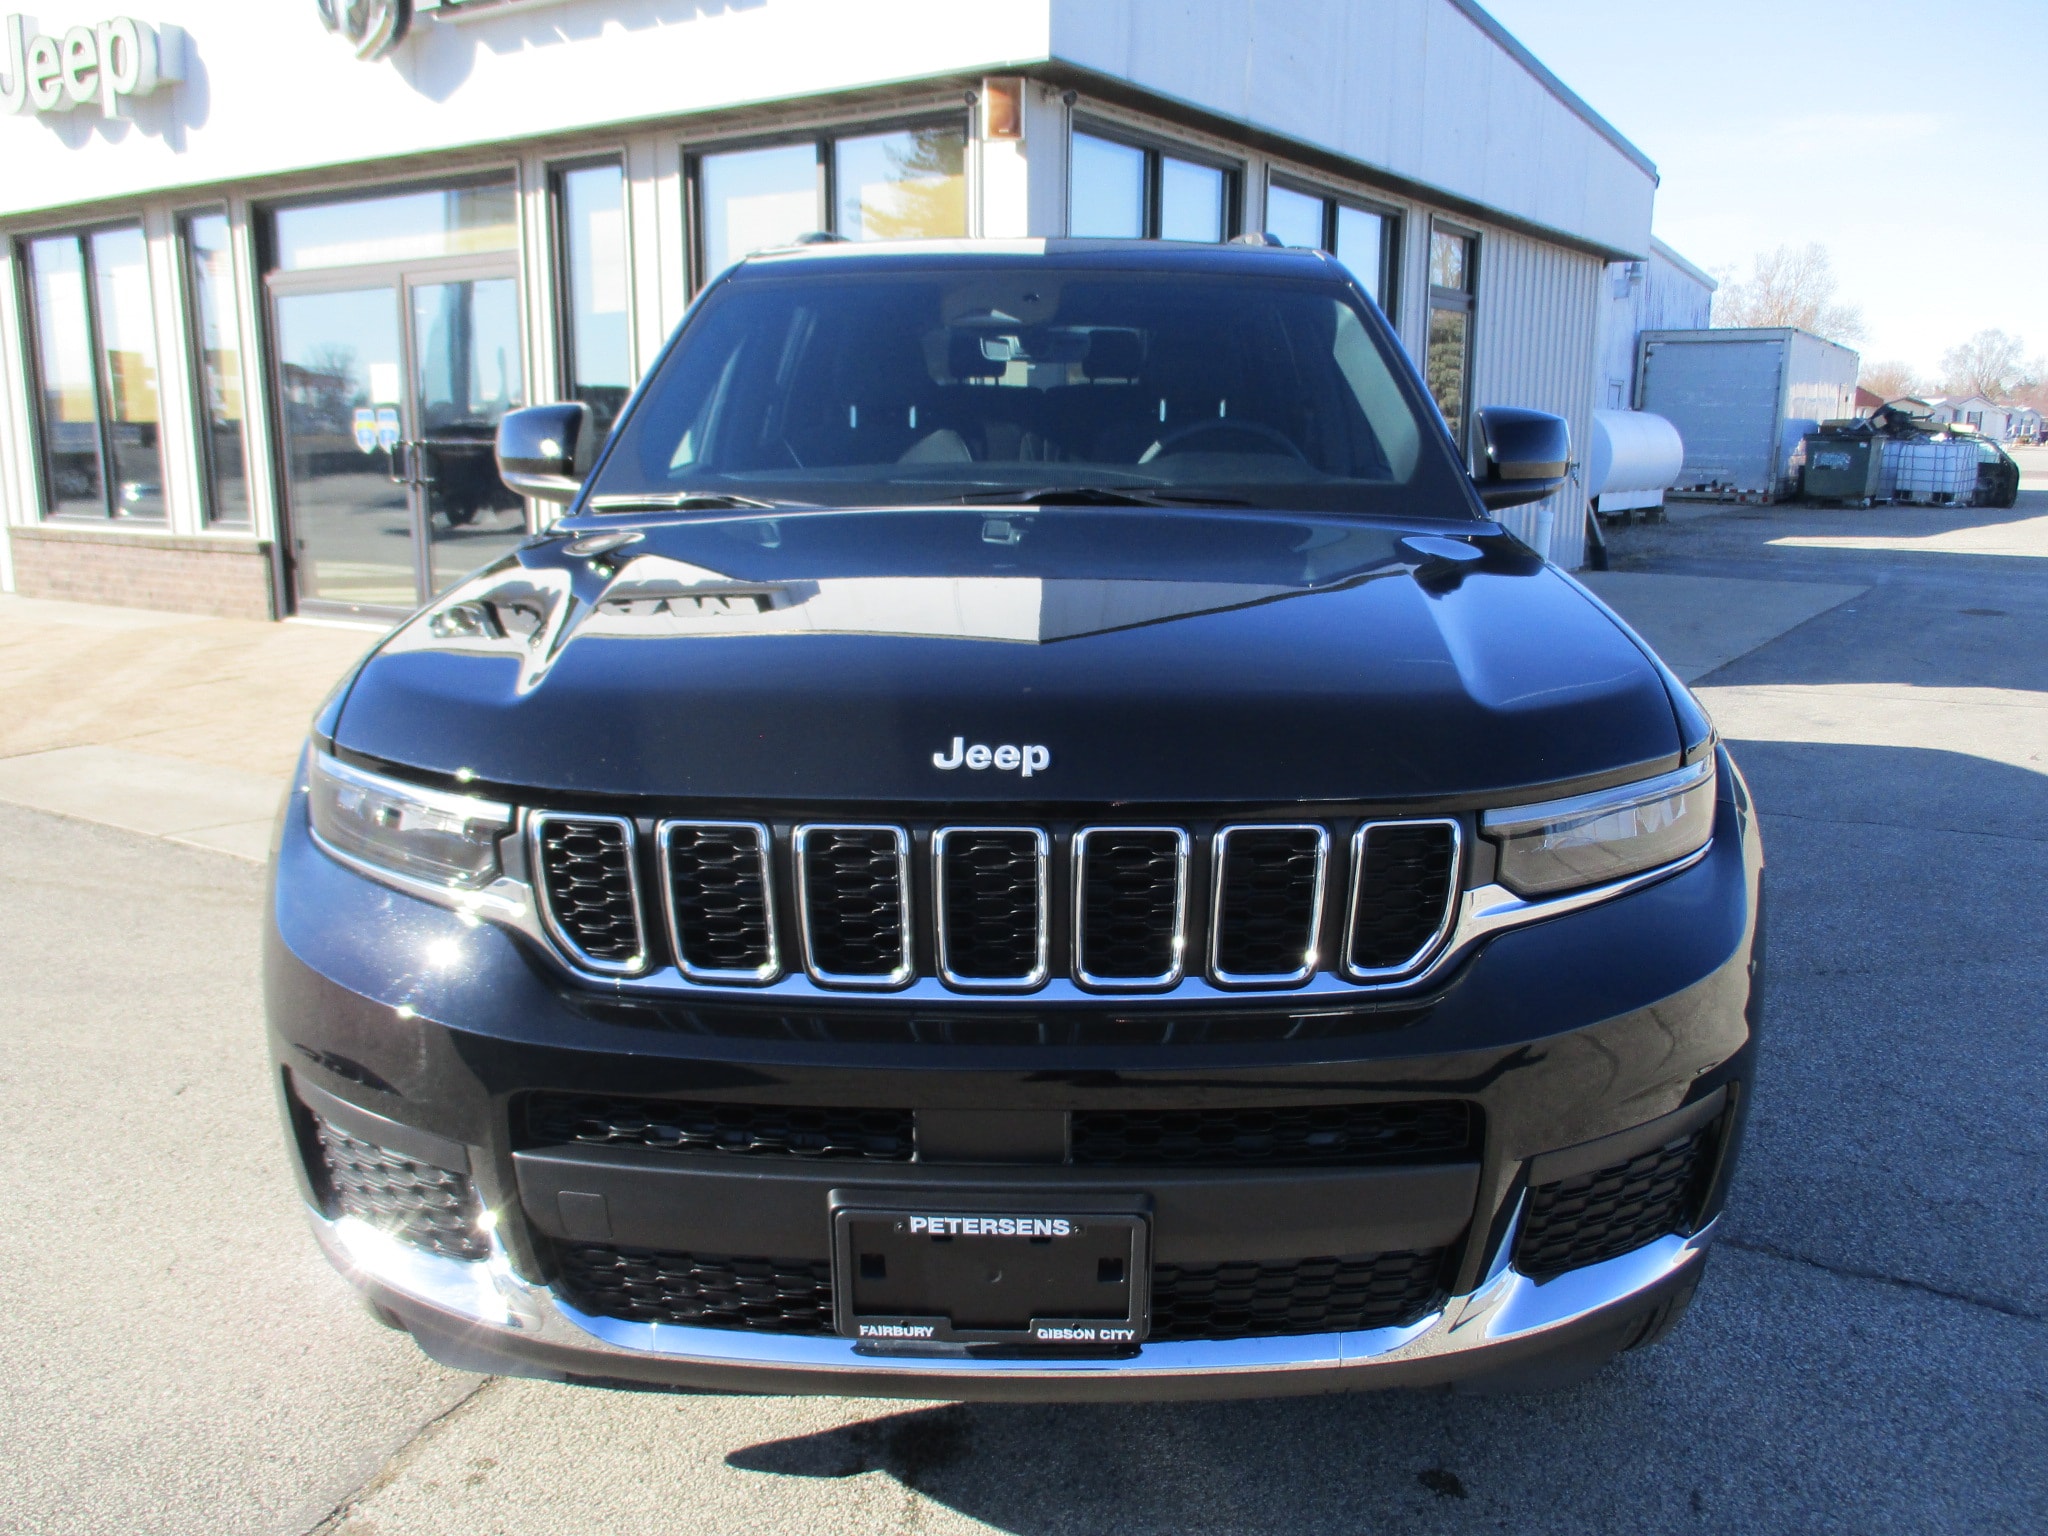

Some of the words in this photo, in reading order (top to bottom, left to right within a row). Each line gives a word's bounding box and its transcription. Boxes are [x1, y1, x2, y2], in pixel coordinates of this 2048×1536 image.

[0, 13, 140, 119] Jeep
[933, 736, 1050, 777] Jeep
[909, 1215, 1070, 1236] PETERSENS
[859, 1324, 934, 1338] FAIRBURY
[1037, 1328, 1095, 1341] GIBSON
[1099, 1328, 1136, 1341] CITY
